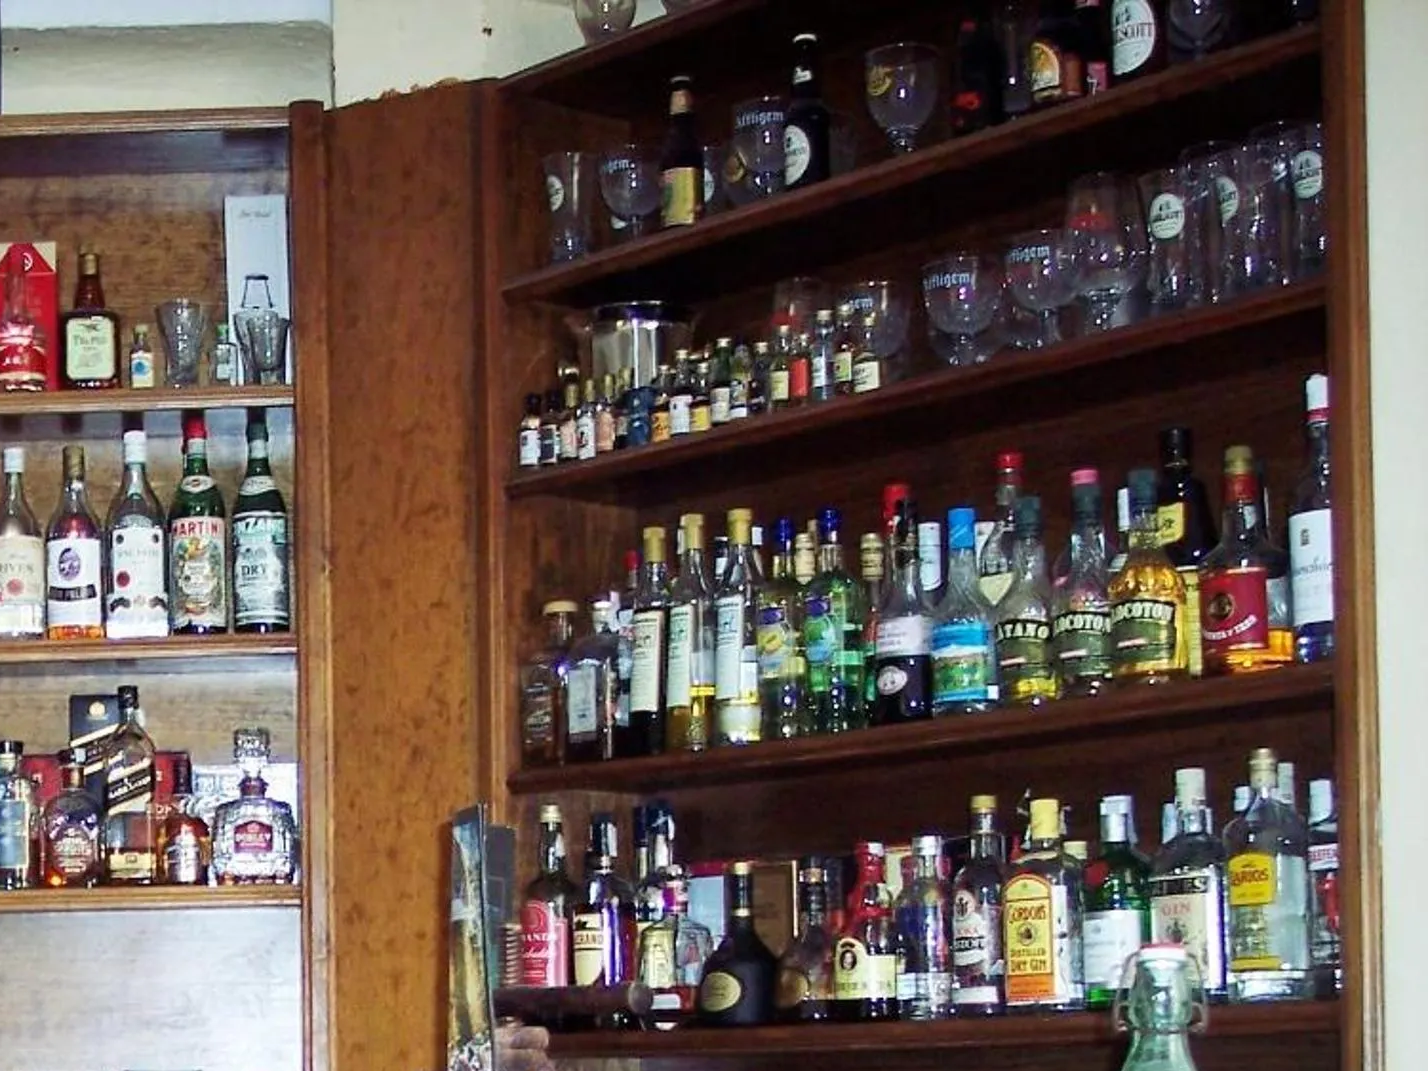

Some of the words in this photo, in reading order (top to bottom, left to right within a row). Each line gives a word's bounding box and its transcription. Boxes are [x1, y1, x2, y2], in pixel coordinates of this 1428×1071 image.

[240, 564, 267, 577] DRY
[1162, 902, 1190, 916] GIN
[1030, 959, 1046, 971] GIN
